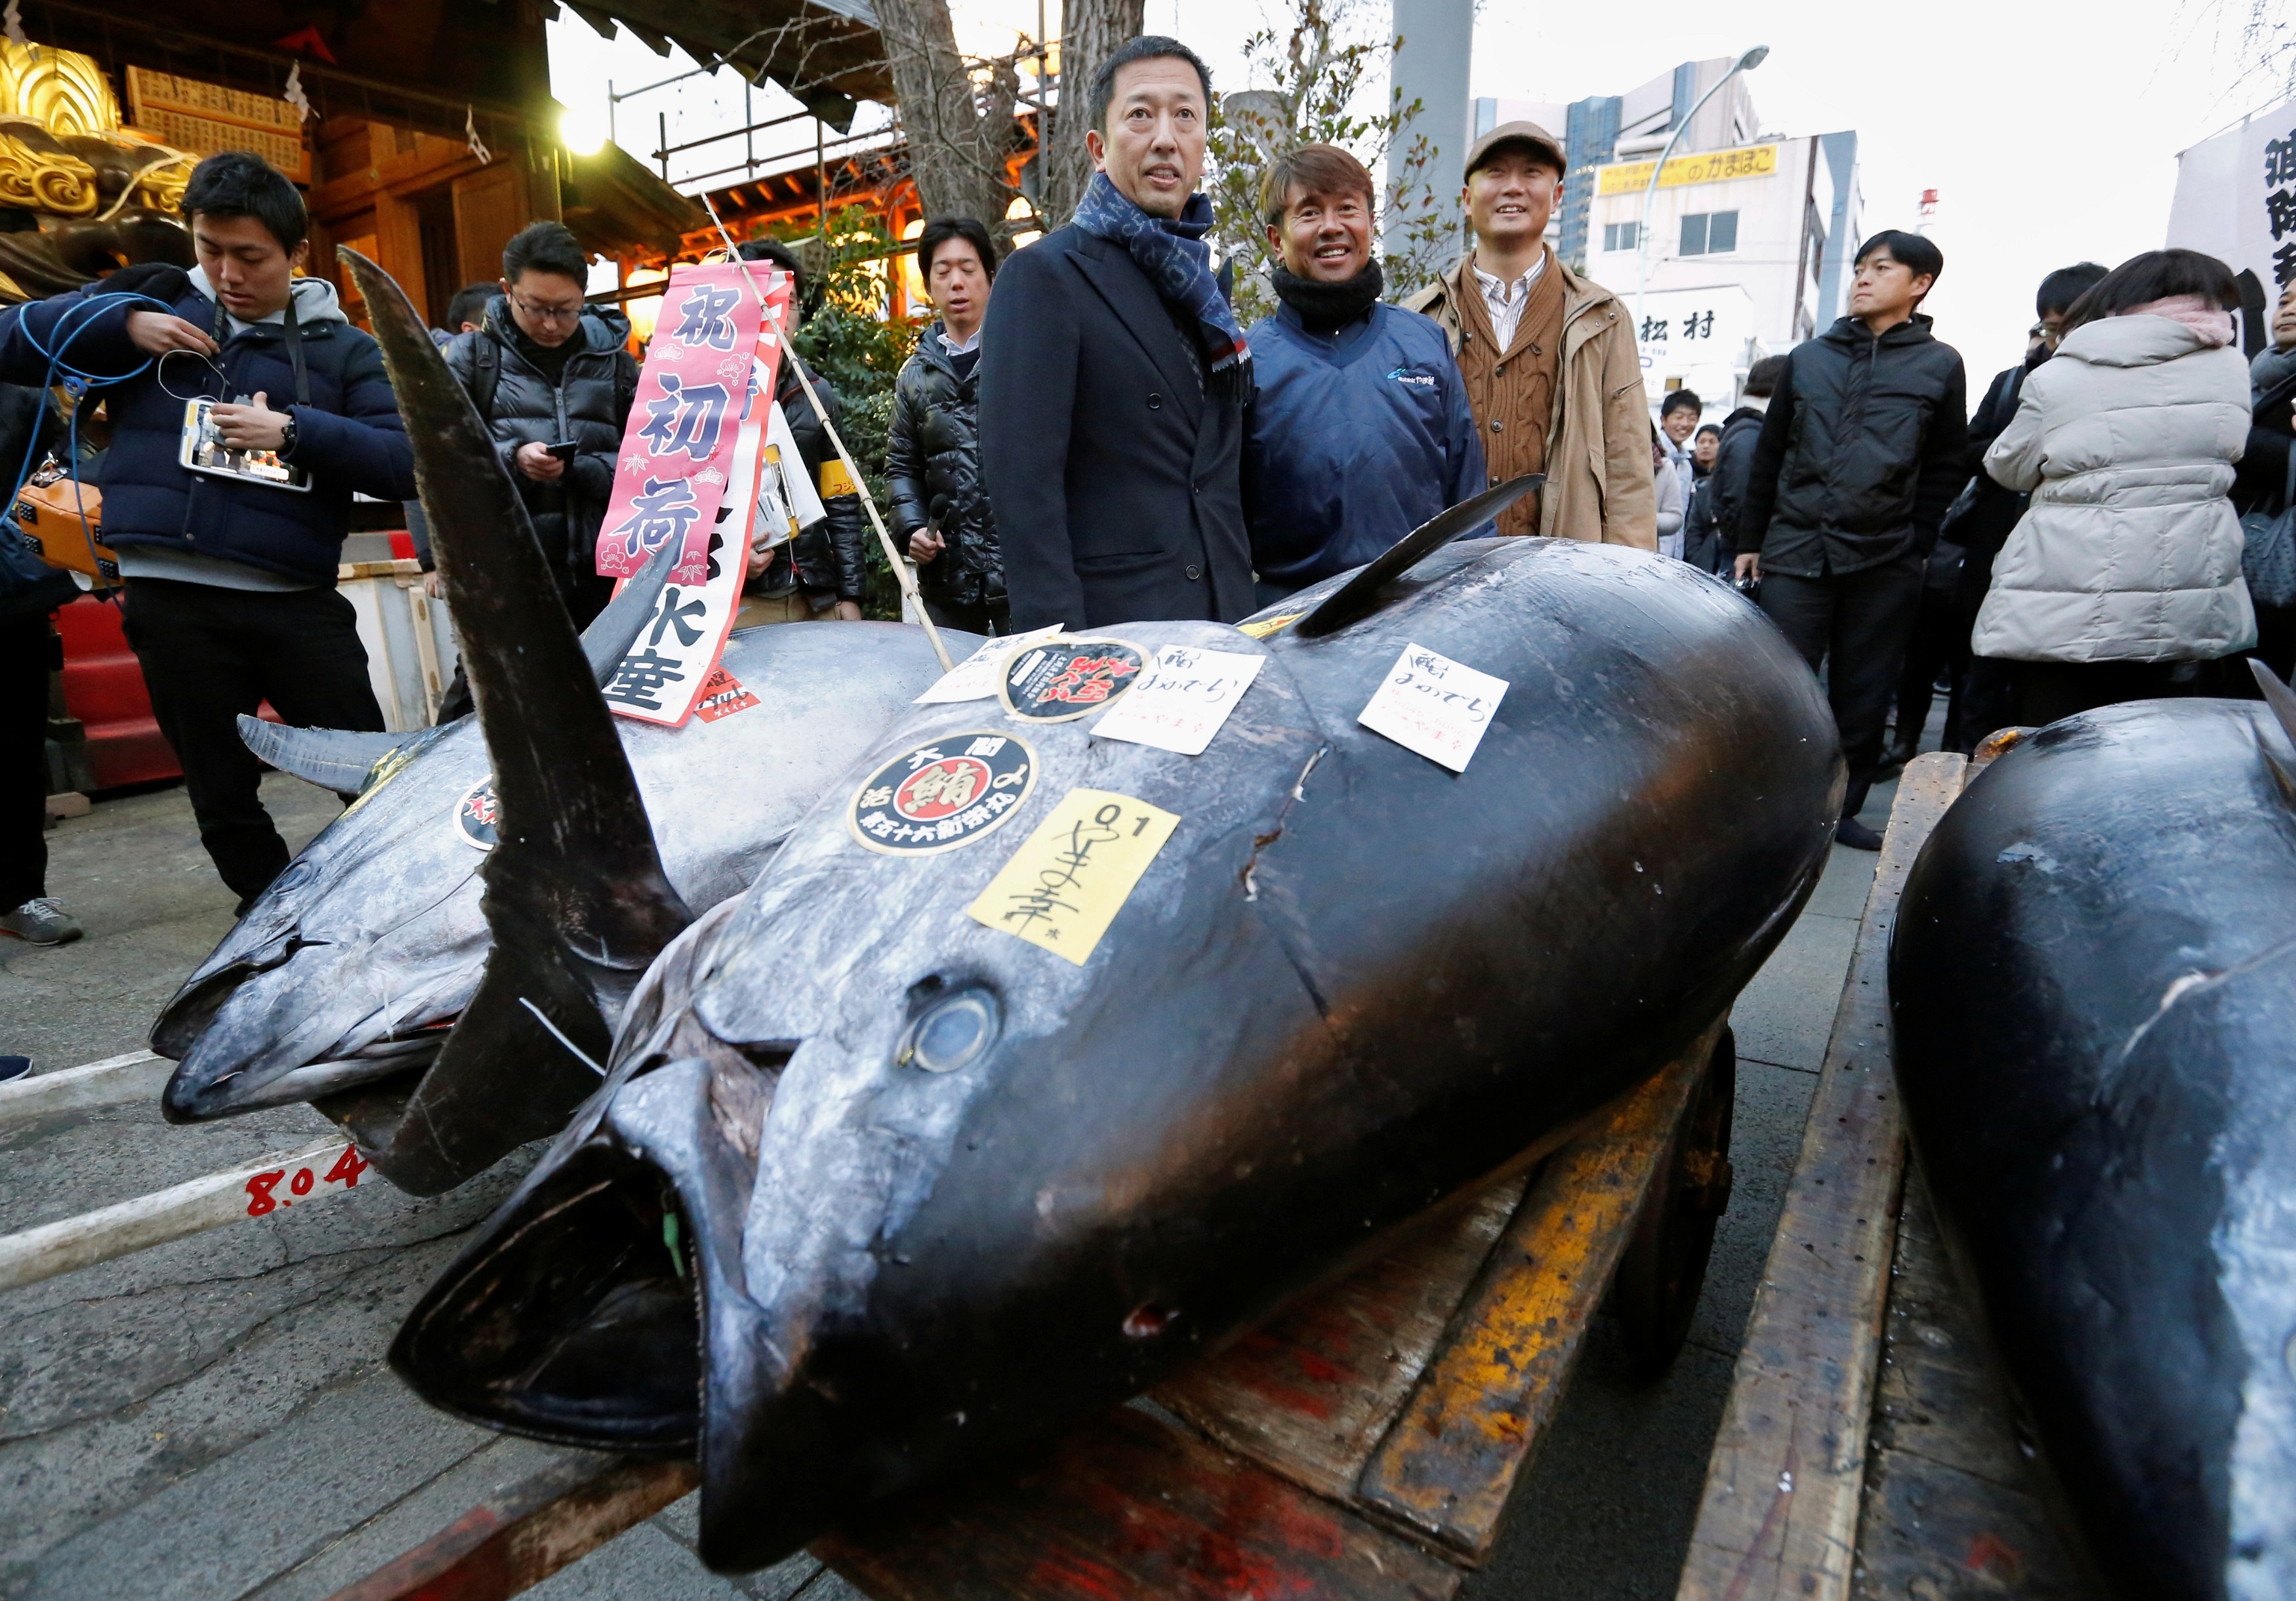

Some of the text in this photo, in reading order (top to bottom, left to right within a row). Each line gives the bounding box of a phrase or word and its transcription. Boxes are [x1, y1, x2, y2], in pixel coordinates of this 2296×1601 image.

[1689, 148, 1771, 182] のかまぼこ
[1641, 310, 1715, 342] 松村
[606, 283, 742, 571] 祝初荷
[714, 700, 748, 718] ダイイチ
[903, 761, 982, 815] 鮪
[1096, 804, 1151, 837] 01
